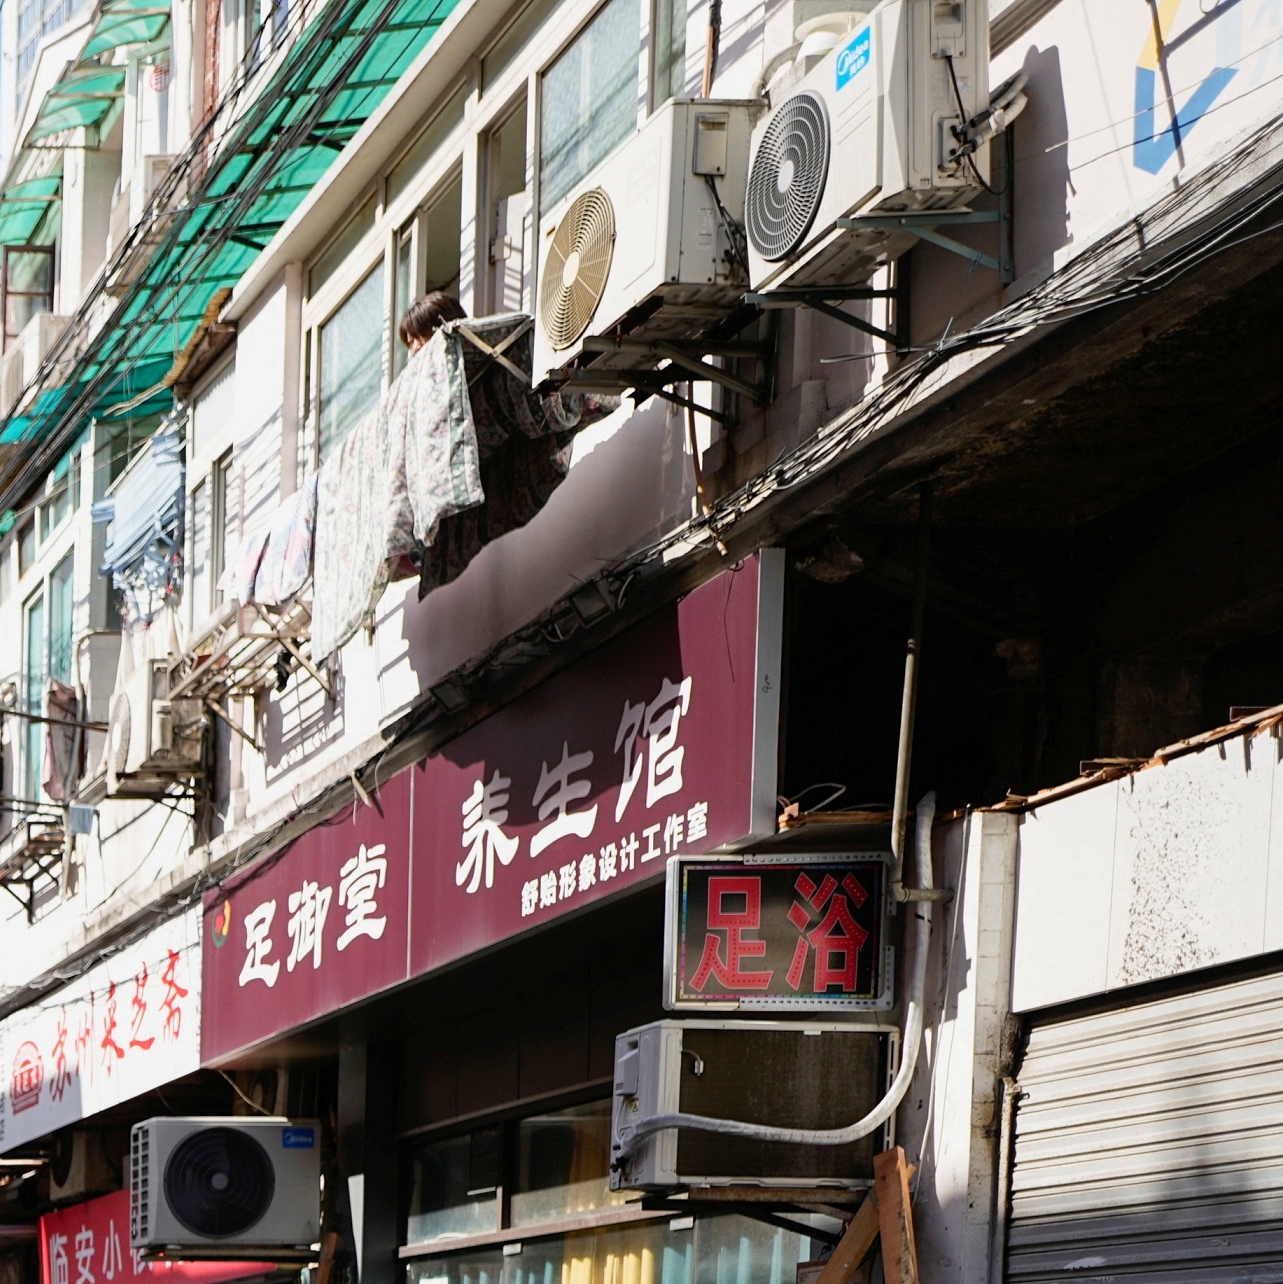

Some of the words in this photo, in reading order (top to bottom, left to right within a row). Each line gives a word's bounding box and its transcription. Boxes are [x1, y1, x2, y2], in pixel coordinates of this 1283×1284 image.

[238, 842, 388, 989] 足御堂
[456, 675, 693, 895] 养生馆
[689, 871, 869, 994] 足浴
